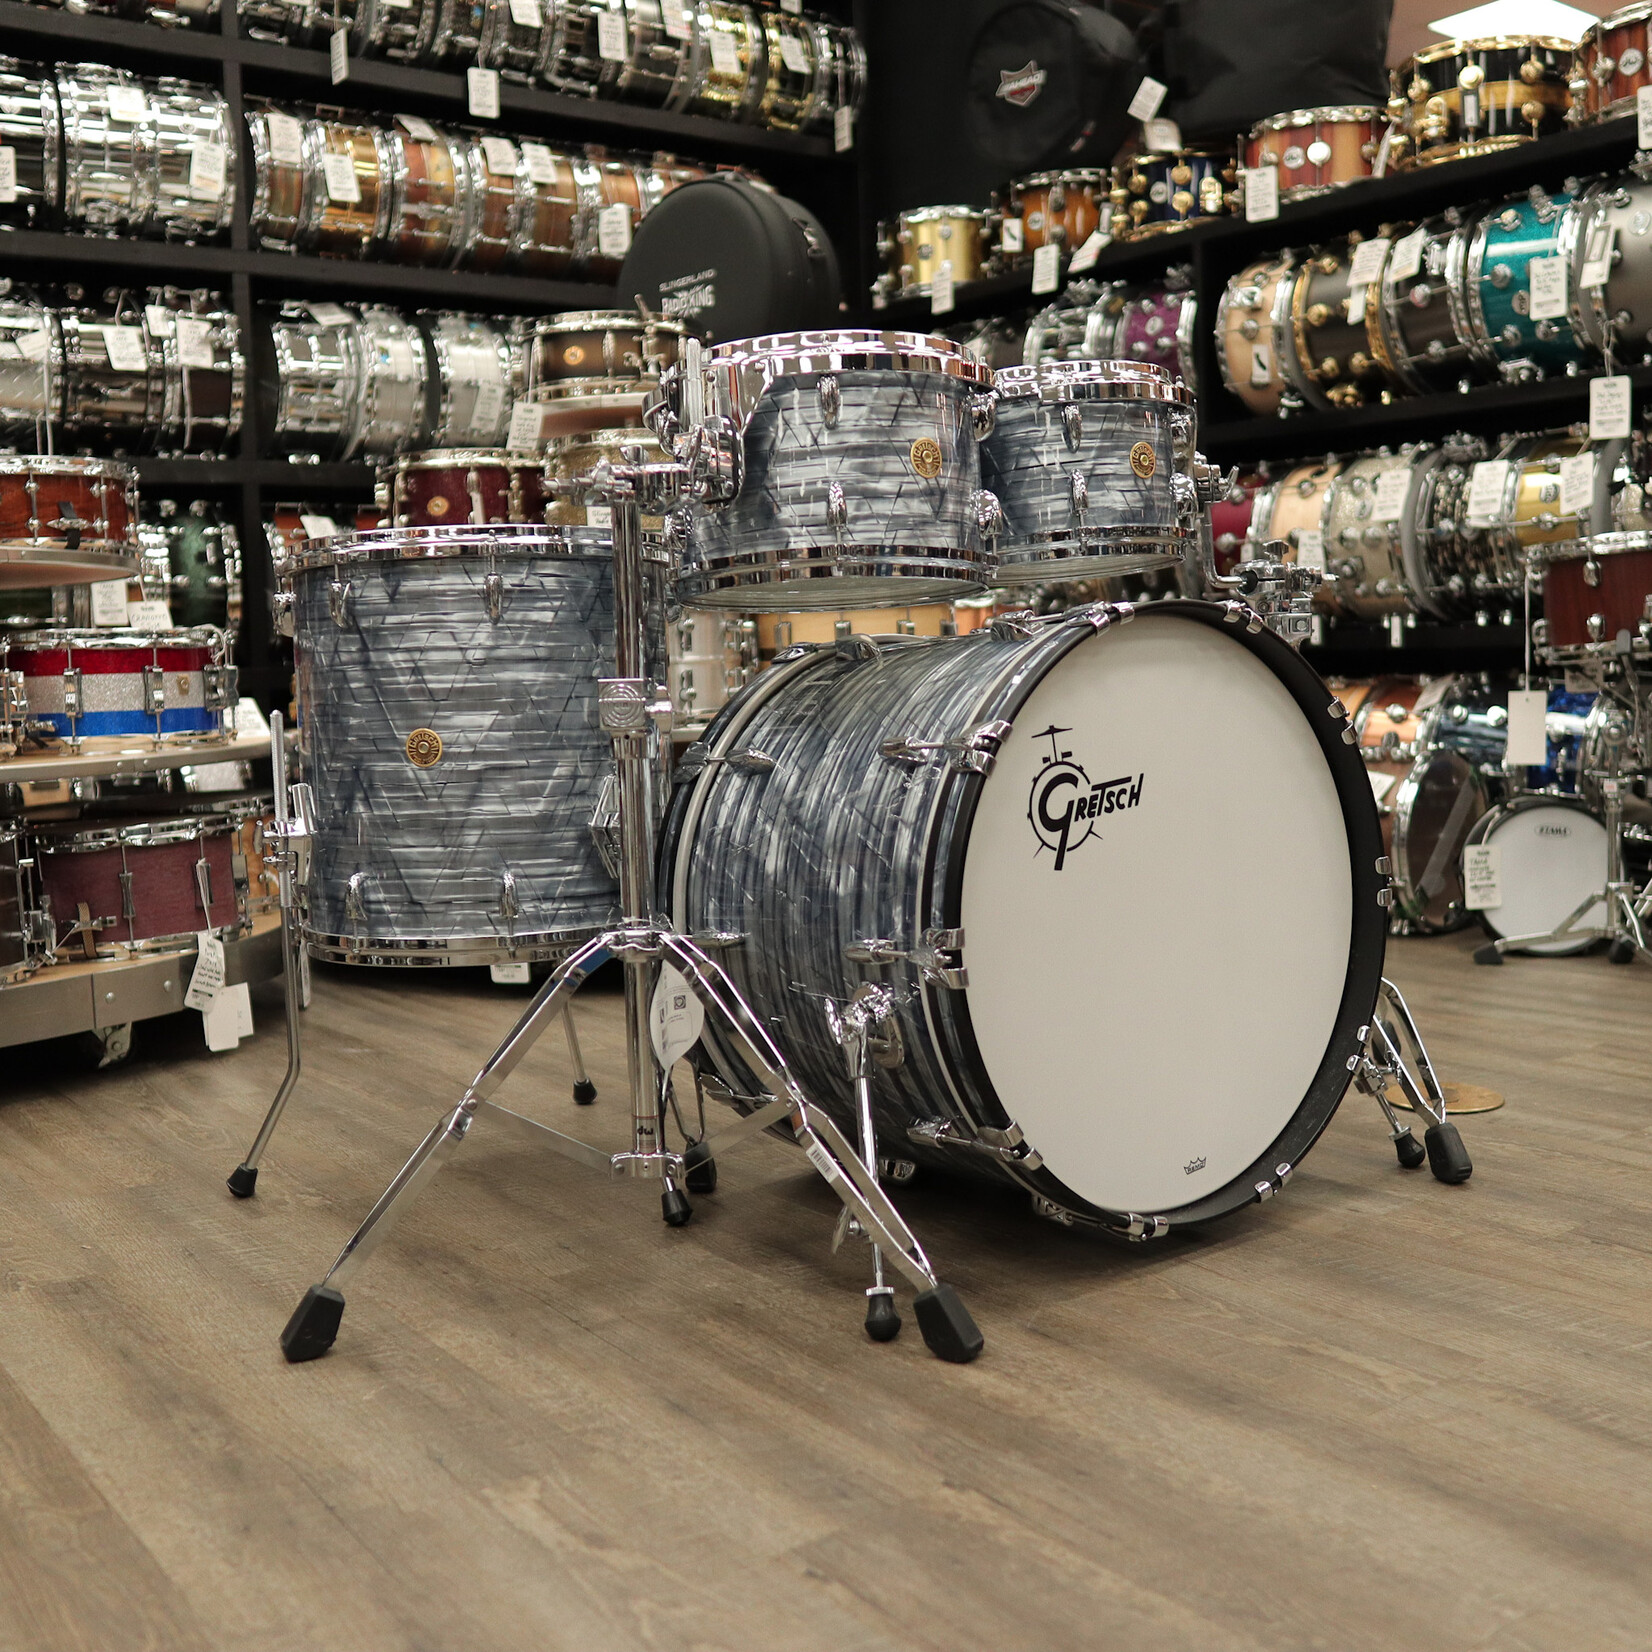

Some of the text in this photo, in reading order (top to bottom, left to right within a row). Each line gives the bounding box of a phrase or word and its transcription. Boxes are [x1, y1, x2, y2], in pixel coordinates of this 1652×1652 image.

[659, 268, 716, 292] SLINGERLAND
[661, 284, 715, 315] RADIO KING
[1544, 825, 1568, 836] TAMA
[637, 1125, 654, 1135] dw
